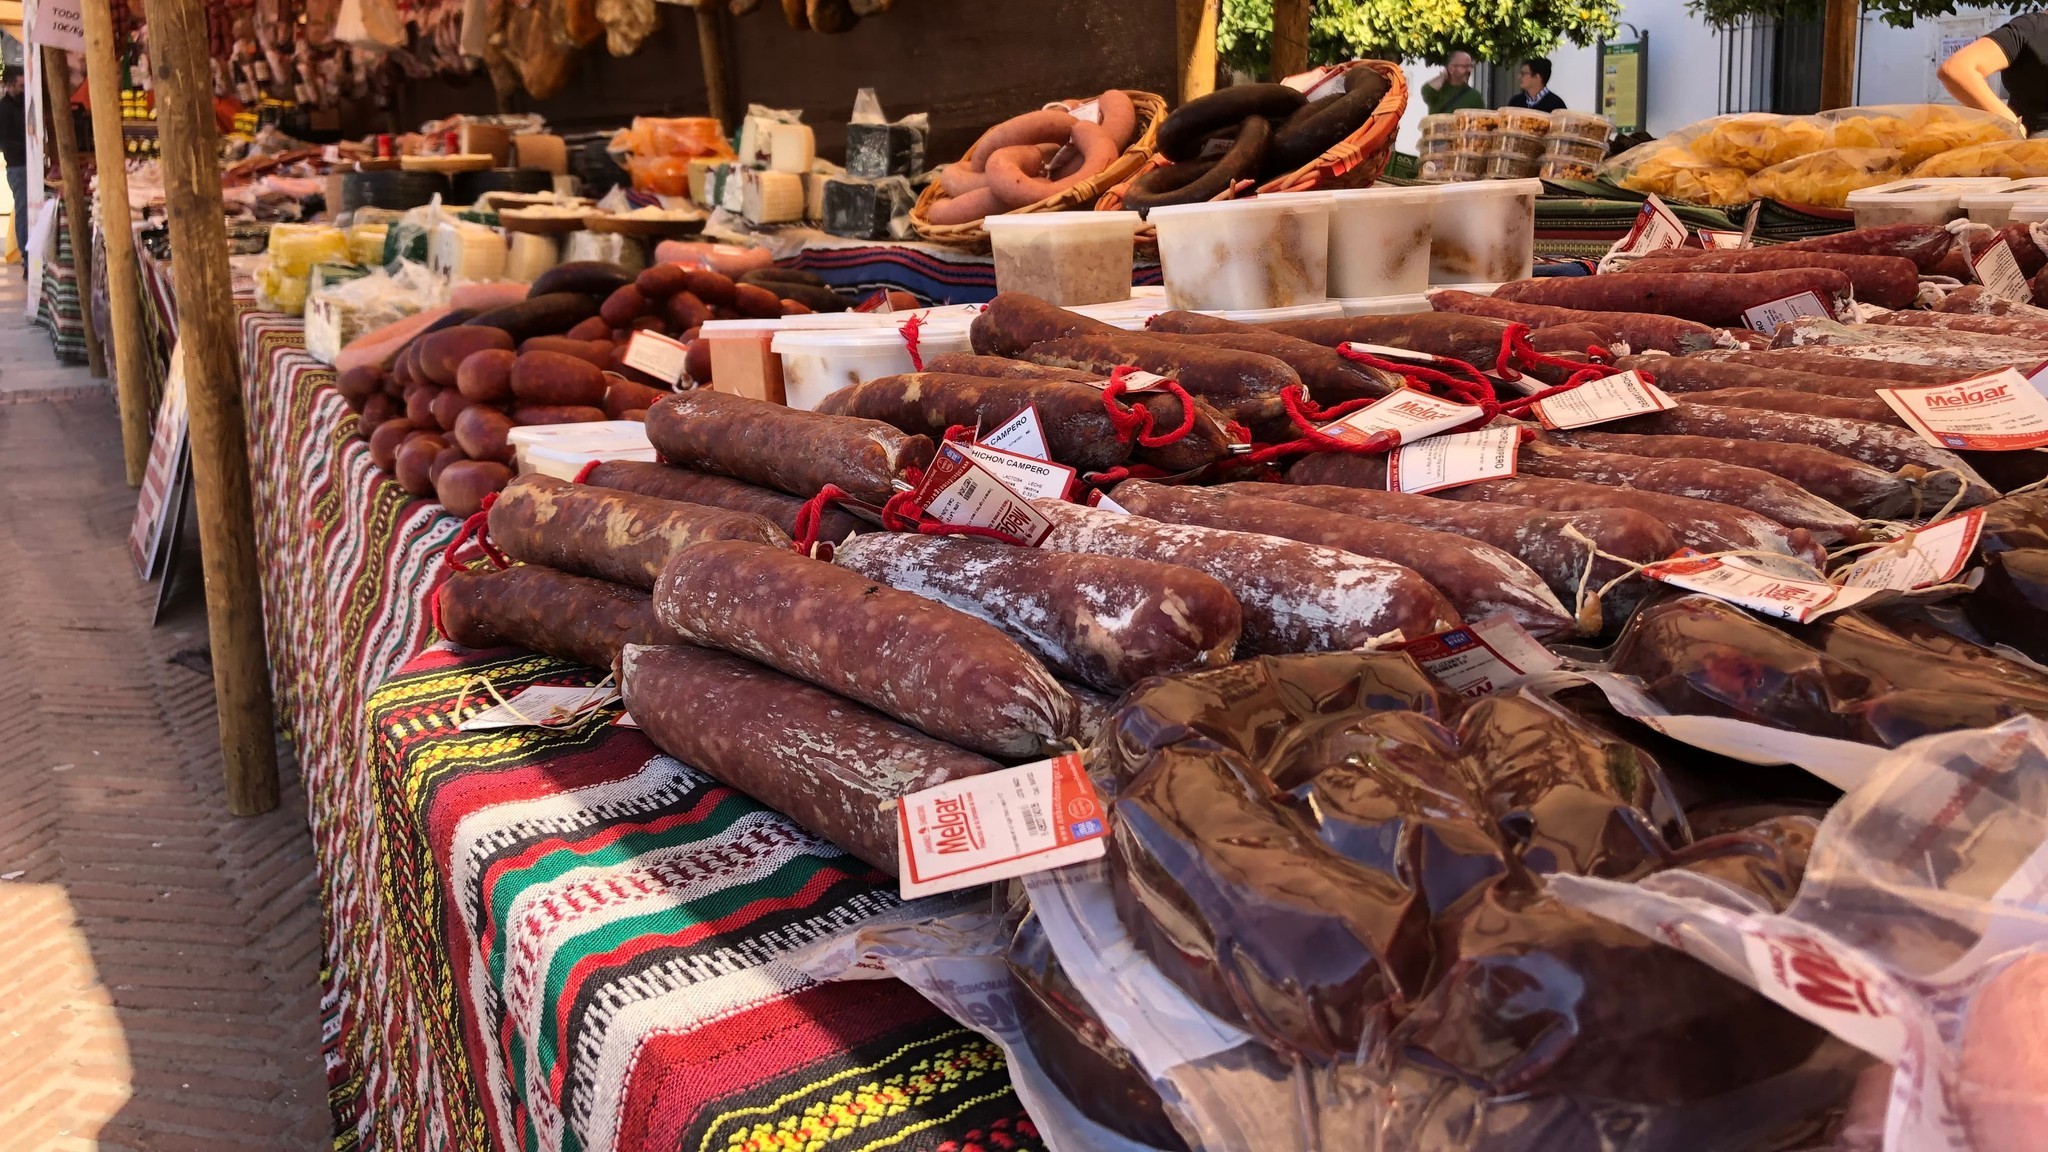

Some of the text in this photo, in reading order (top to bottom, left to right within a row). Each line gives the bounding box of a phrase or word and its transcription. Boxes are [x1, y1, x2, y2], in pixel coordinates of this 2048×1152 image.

[53, 6, 80, 21] TODO
[1924, 384, 2008, 407] Melgar
[990, 416, 1027, 446] CAMPERO
[1006, 459, 1050, 476] CAMPERO
[932, 796, 973, 855] Melgar
